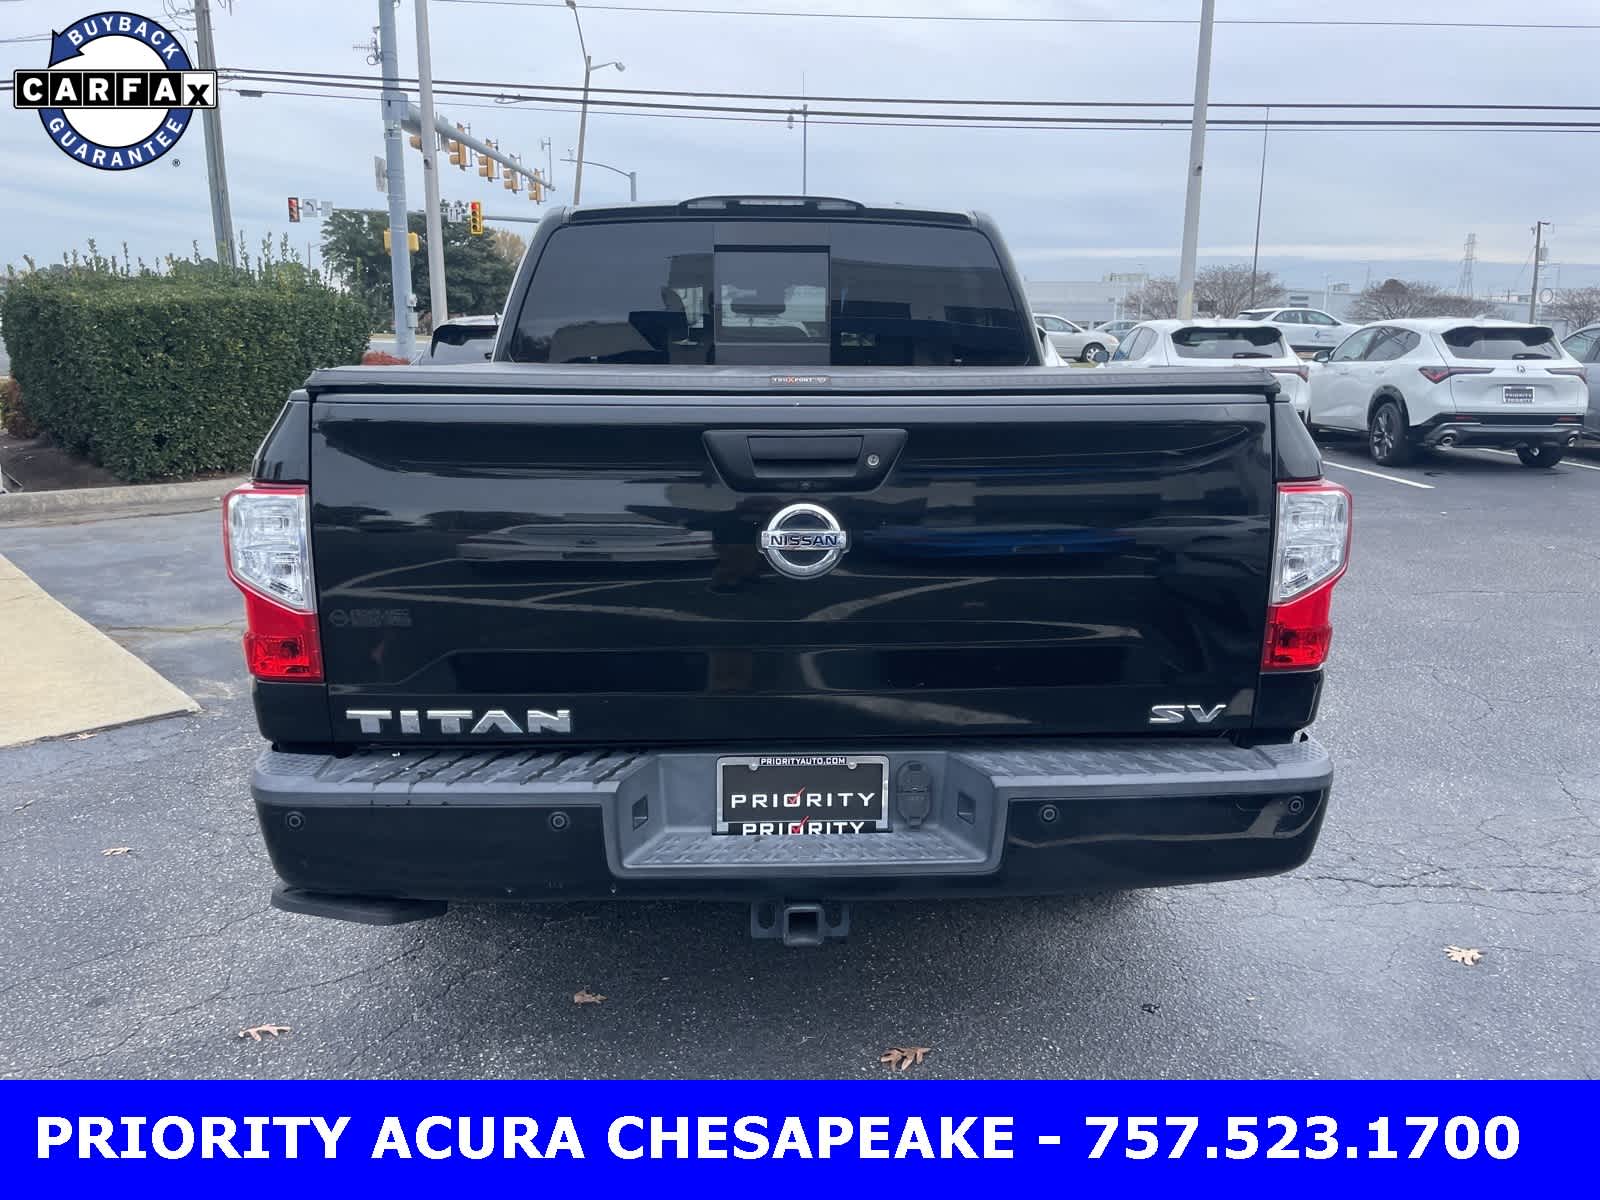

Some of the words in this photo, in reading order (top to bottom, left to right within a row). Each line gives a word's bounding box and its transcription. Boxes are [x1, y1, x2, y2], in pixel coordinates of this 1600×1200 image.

[770, 535, 838, 546] NISSAN
[345, 709, 572, 734] TITAN
[1149, 704, 1227, 724] SV
[760, 757, 847, 765] PRIORITYAUTO.COM
[731, 792, 876, 808] PRIORITY
[742, 822, 865, 836] PRIORITY
